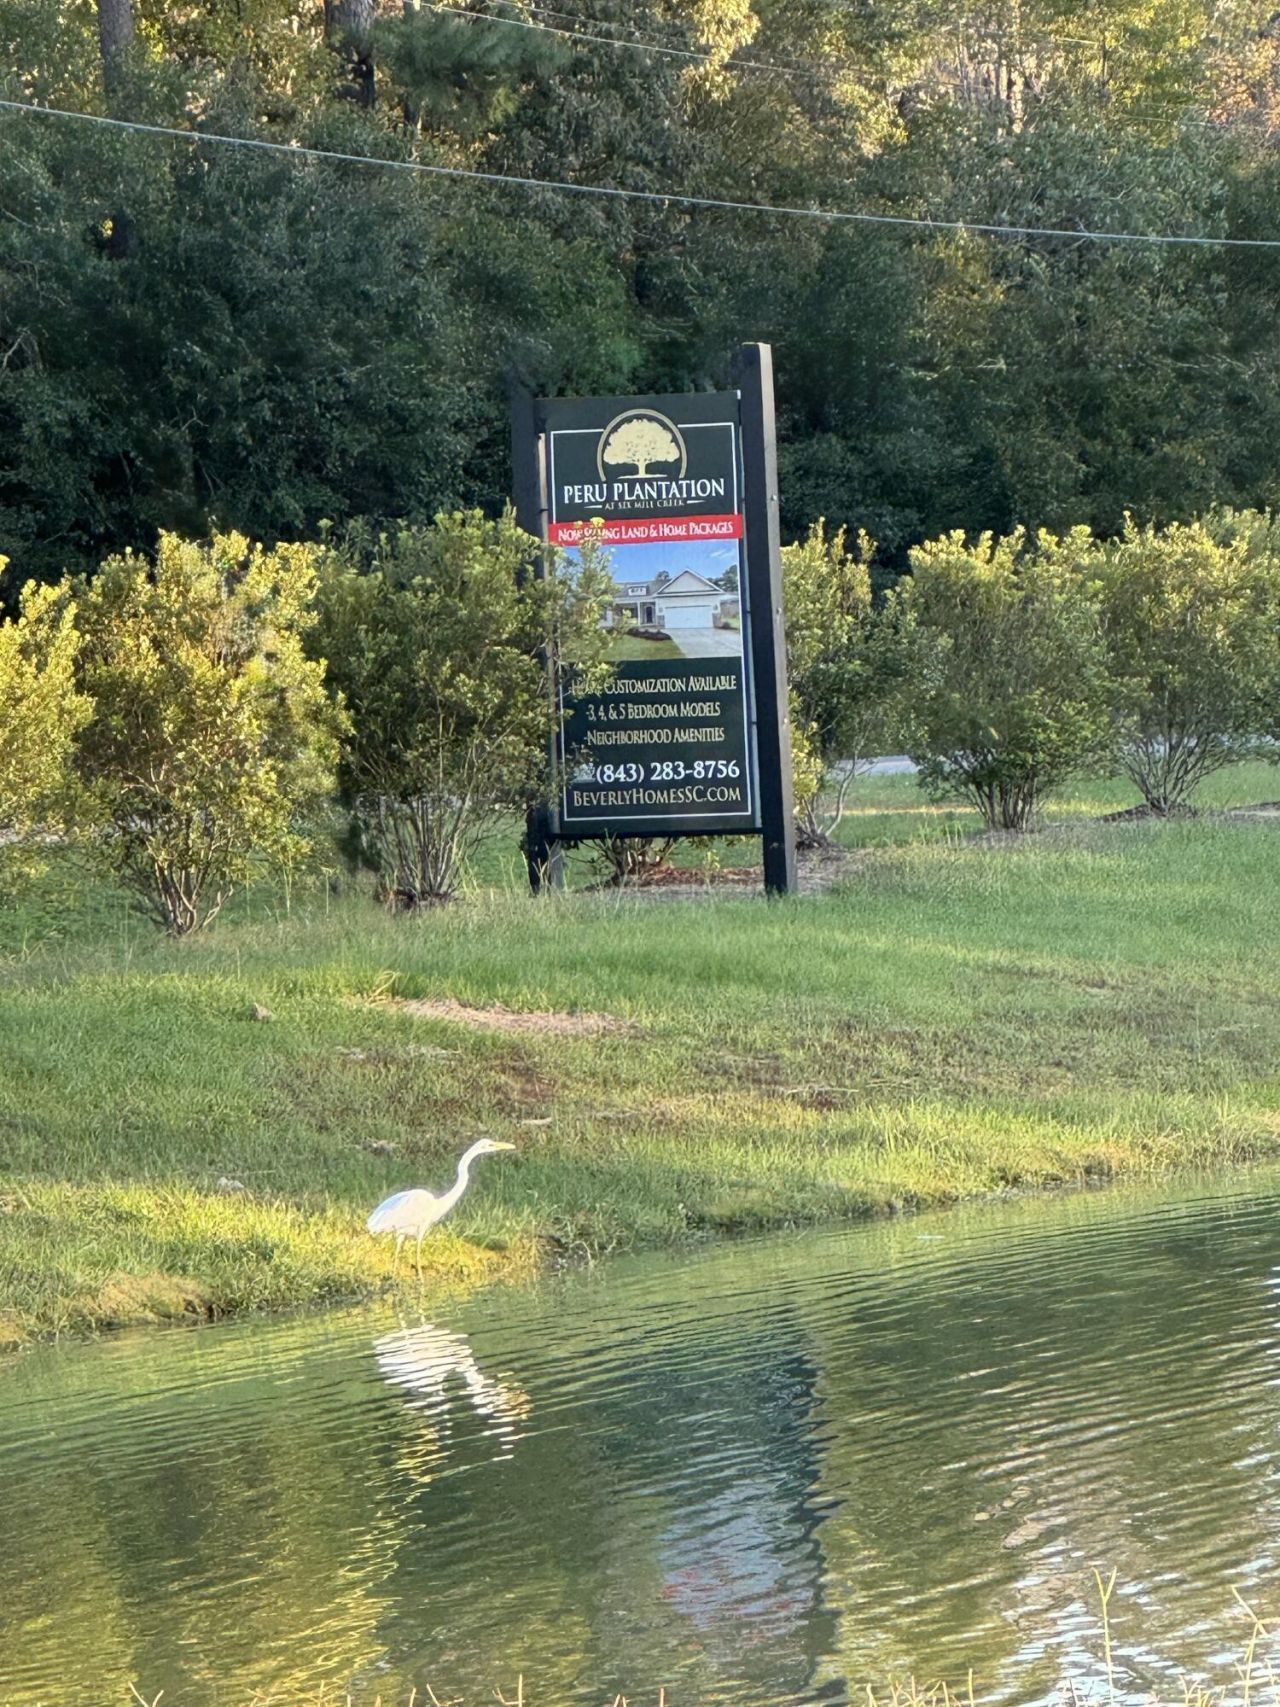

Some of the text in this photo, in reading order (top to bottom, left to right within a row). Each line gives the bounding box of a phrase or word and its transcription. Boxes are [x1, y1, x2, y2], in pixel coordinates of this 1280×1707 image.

[564, 478, 724, 504] PERU PLANTATION
[622, 524, 648, 538] LAND
[650, 524, 658, 536] &
[659, 522, 688, 536] HOME
[689, 521, 733, 536] PACKAGES
[604, 678, 686, 694] CUSTOMIZATION
[688, 675, 736, 691] AVAILABLE
[598, 704, 608, 721] 4,
[608, 703, 618, 720] &
[619, 702, 626, 719] 5
[628, 702, 679, 719] BEDROOM
[680, 702, 720, 718] MODELS
[673, 727, 724, 743] AMENITIES
[596, 760, 740, 784] (843) 283-8756
